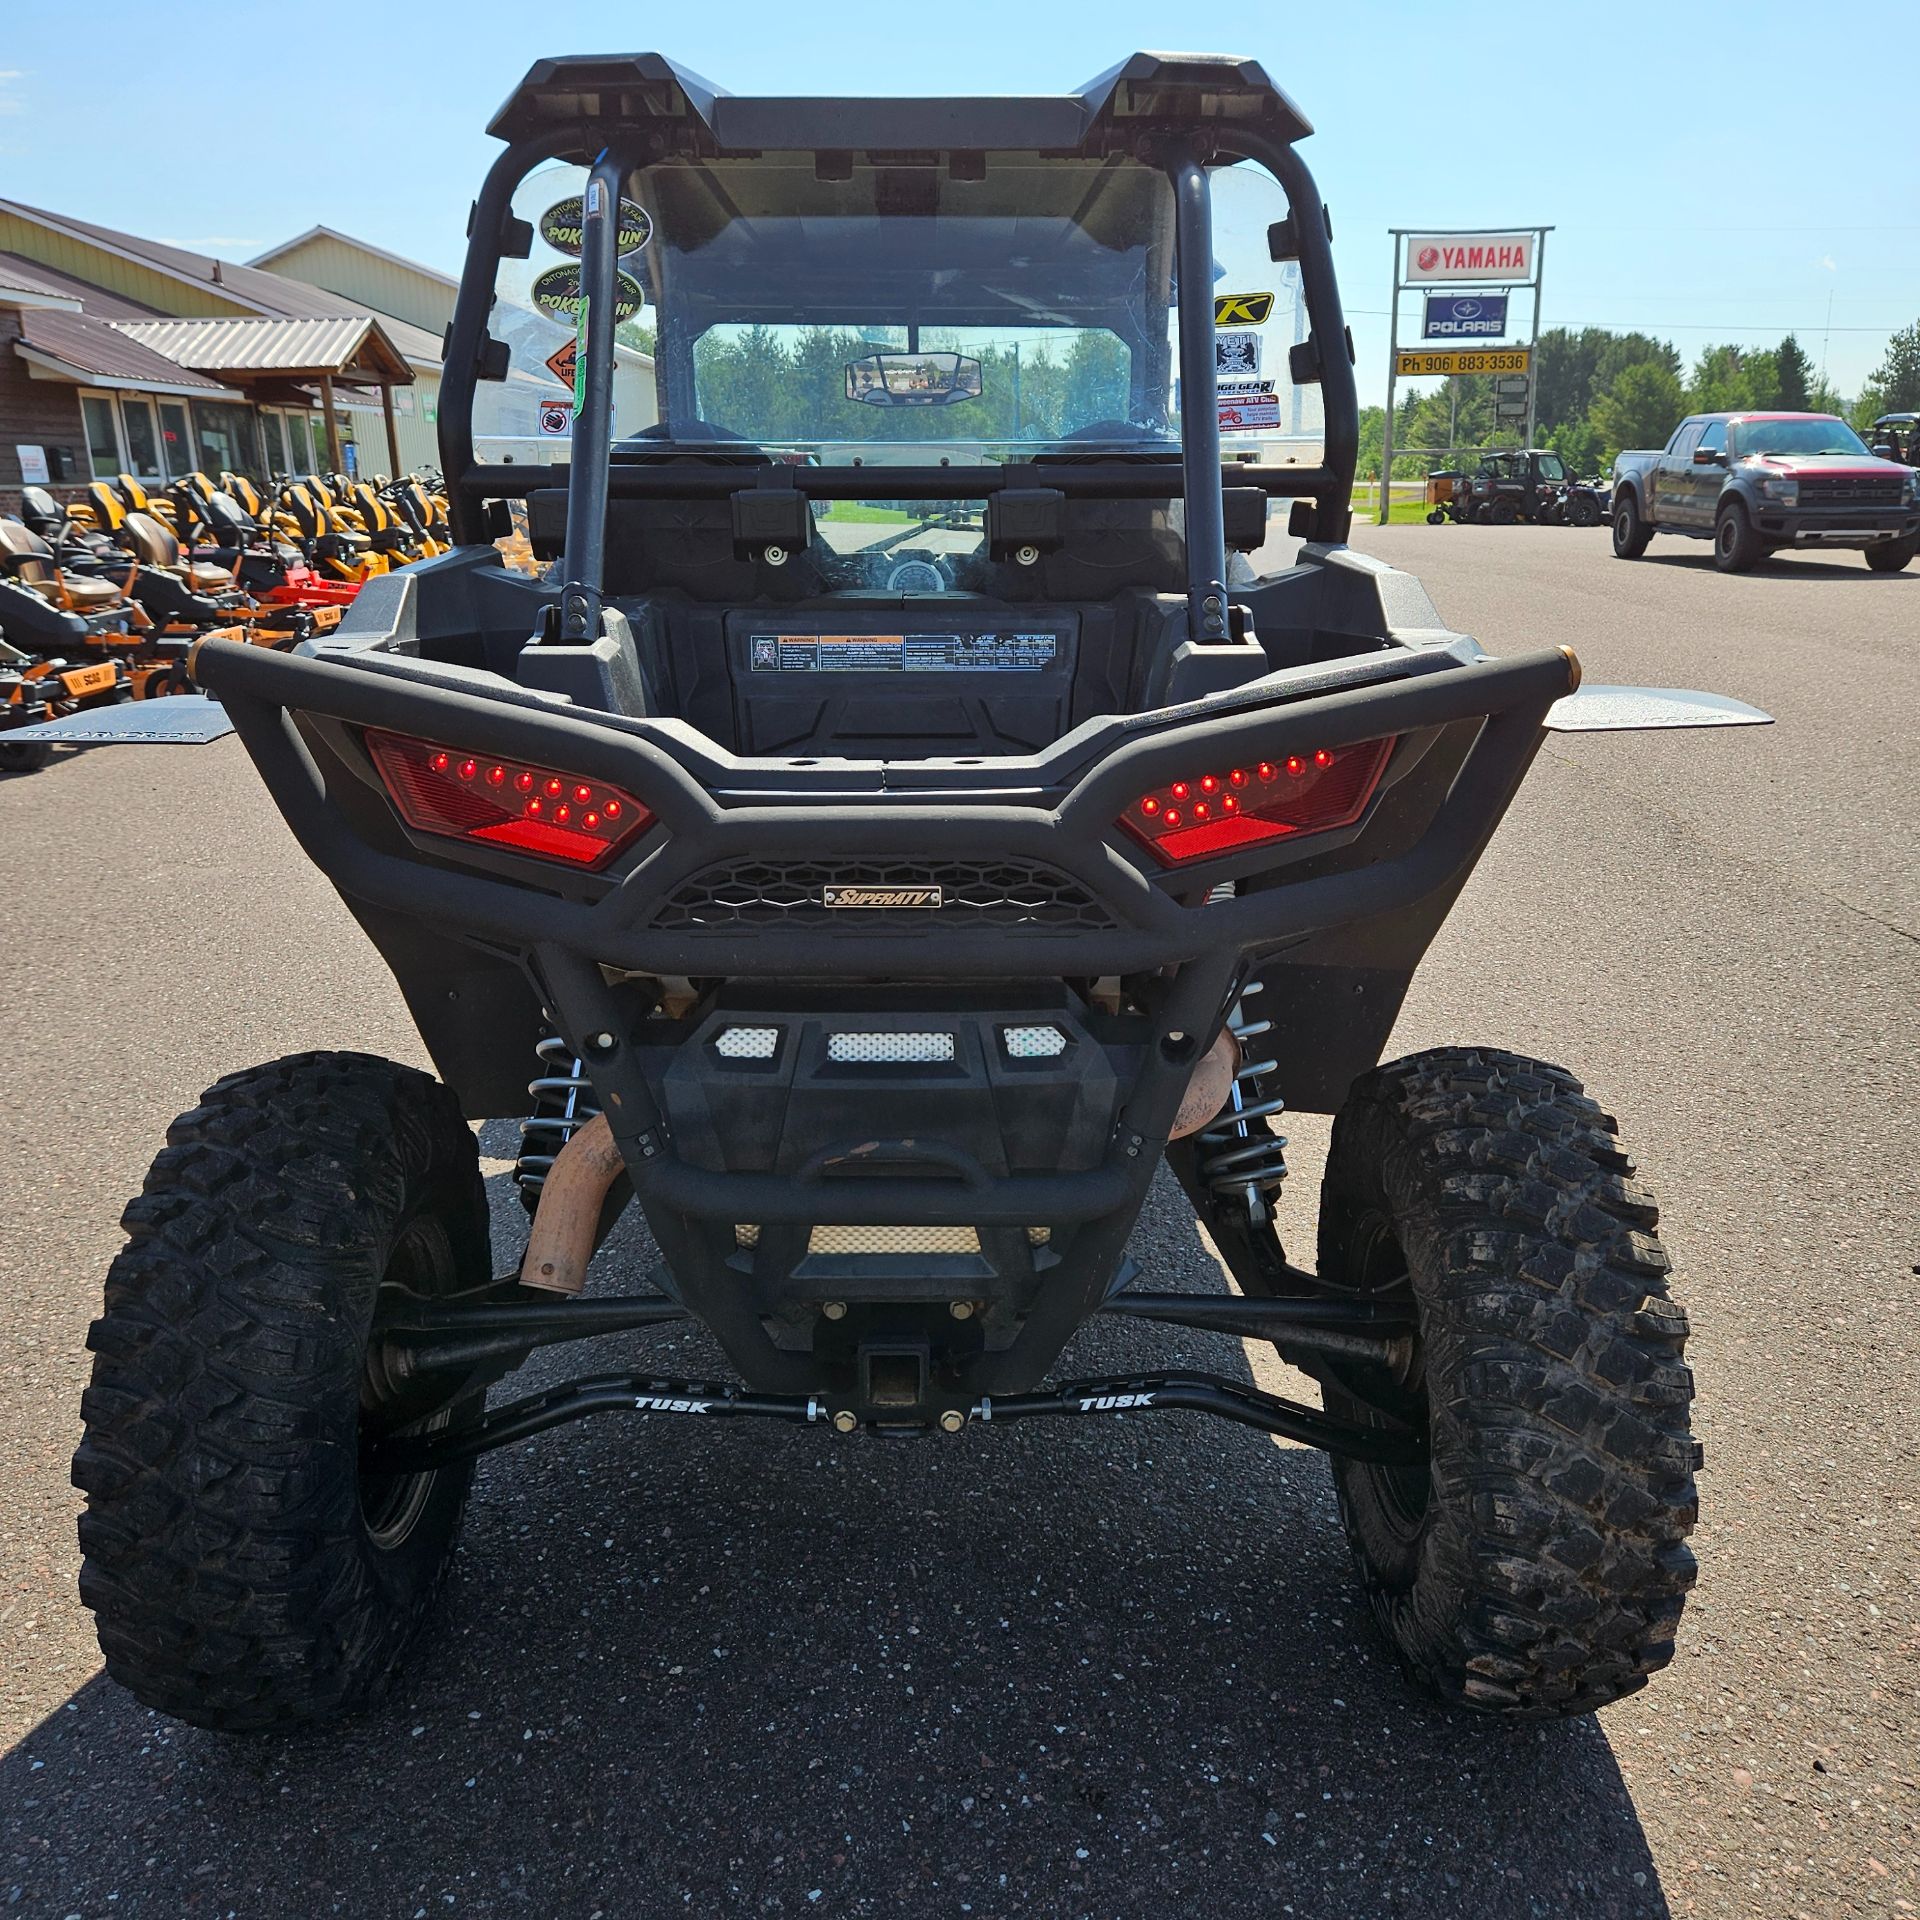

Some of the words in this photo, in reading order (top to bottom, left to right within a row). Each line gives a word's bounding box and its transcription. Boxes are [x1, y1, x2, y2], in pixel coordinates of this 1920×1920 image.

[549, 200, 583, 219] ONTONA
[548, 227, 583, 245] POK
[619, 230, 642, 244] UN
[1442, 246, 1524, 269] YAMAHA
[541, 267, 581, 286] ONTONAG
[621, 281, 637, 295] FAIR
[540, 294, 580, 316] POKE
[1428, 320, 1502, 333] POLARIS
[1216, 335, 1250, 345] YETI
[1402, 357, 1420, 371] Ph
[1458, 355, 1524, 370] 883-3536
[1217, 383, 1236, 391] IGG
[1238, 381, 1271, 392] GEAR
[1246, 396, 1259, 404] ATV
[834, 889, 931, 905] SUPERATV
[635, 1397, 713, 1414] TUSK
[1080, 1392, 1156, 1411] TUSK
